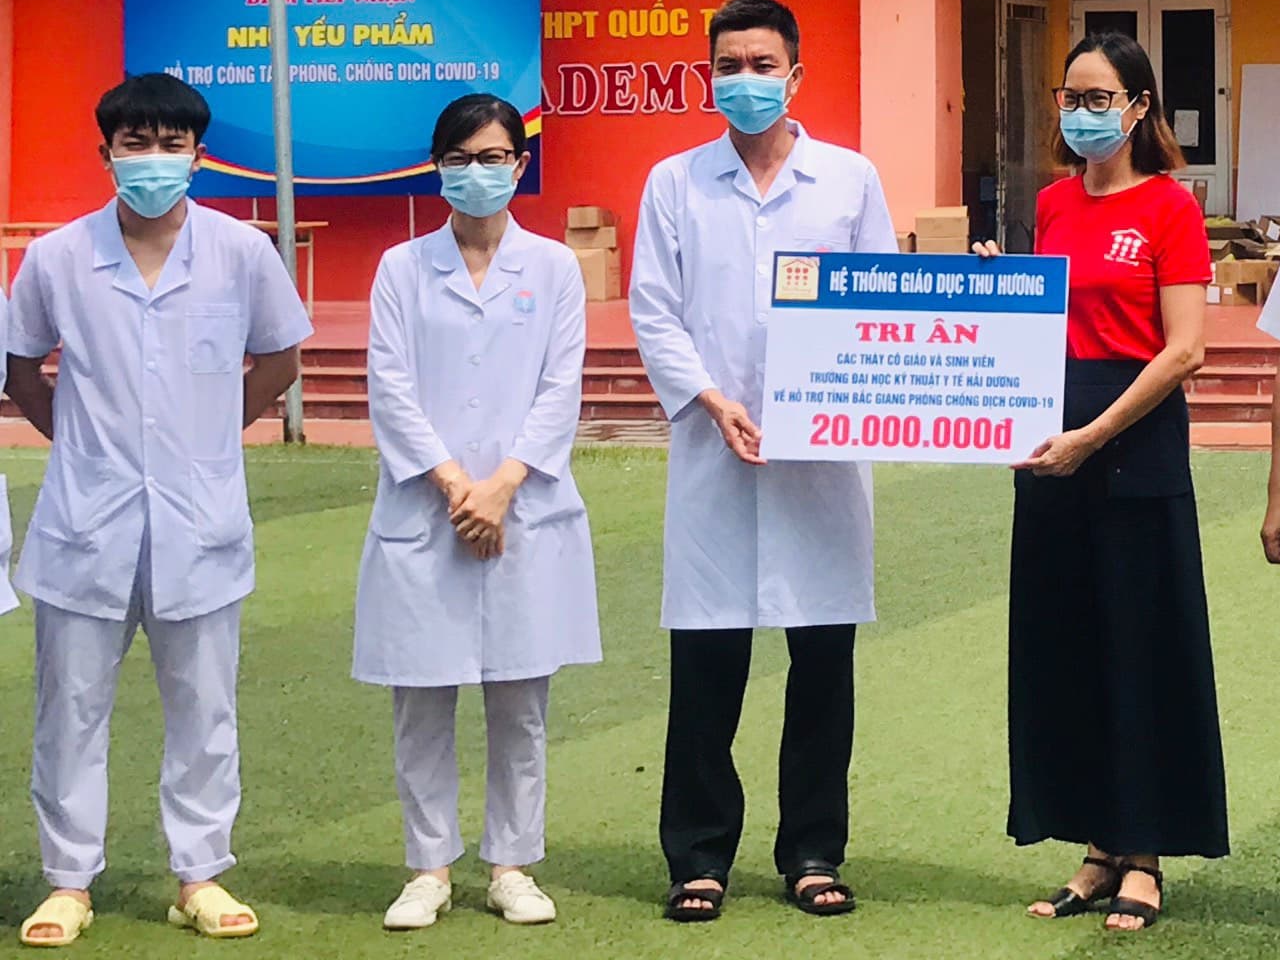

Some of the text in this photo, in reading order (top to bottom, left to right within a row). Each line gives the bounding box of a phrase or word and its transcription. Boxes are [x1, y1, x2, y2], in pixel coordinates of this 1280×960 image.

[227, 11, 434, 48] NH YẾU PHẨM
[541, 10, 599, 39] HPT
[187, 64, 214, 89] TRỢ
[217, 61, 255, 84] CÔNG
[346, 57, 394, 81] CHỐNG
[398, 62, 431, 85] DỊCH
[435, 61, 500, 81] COVID-19
[541, 60, 719, 115] DEMY
[829, 264, 1045, 299] HỆ THỐNG GIÁO DỤC THU HƯƠNG
[855, 318, 979, 344] TRI ÂN
[836, 352, 857, 365] CÁC
[903, 352, 927, 367] GIÁO
[945, 355, 969, 368] SINH
[871, 373, 891, 388] HỌC
[942, 376, 949, 388] Y
[875, 392, 906, 405] GIANG
[982, 395, 1006, 410] DỊCH
[1008, 396, 1054, 409] COVID-19
[809, 413, 1014, 450] 20.000.000đ
